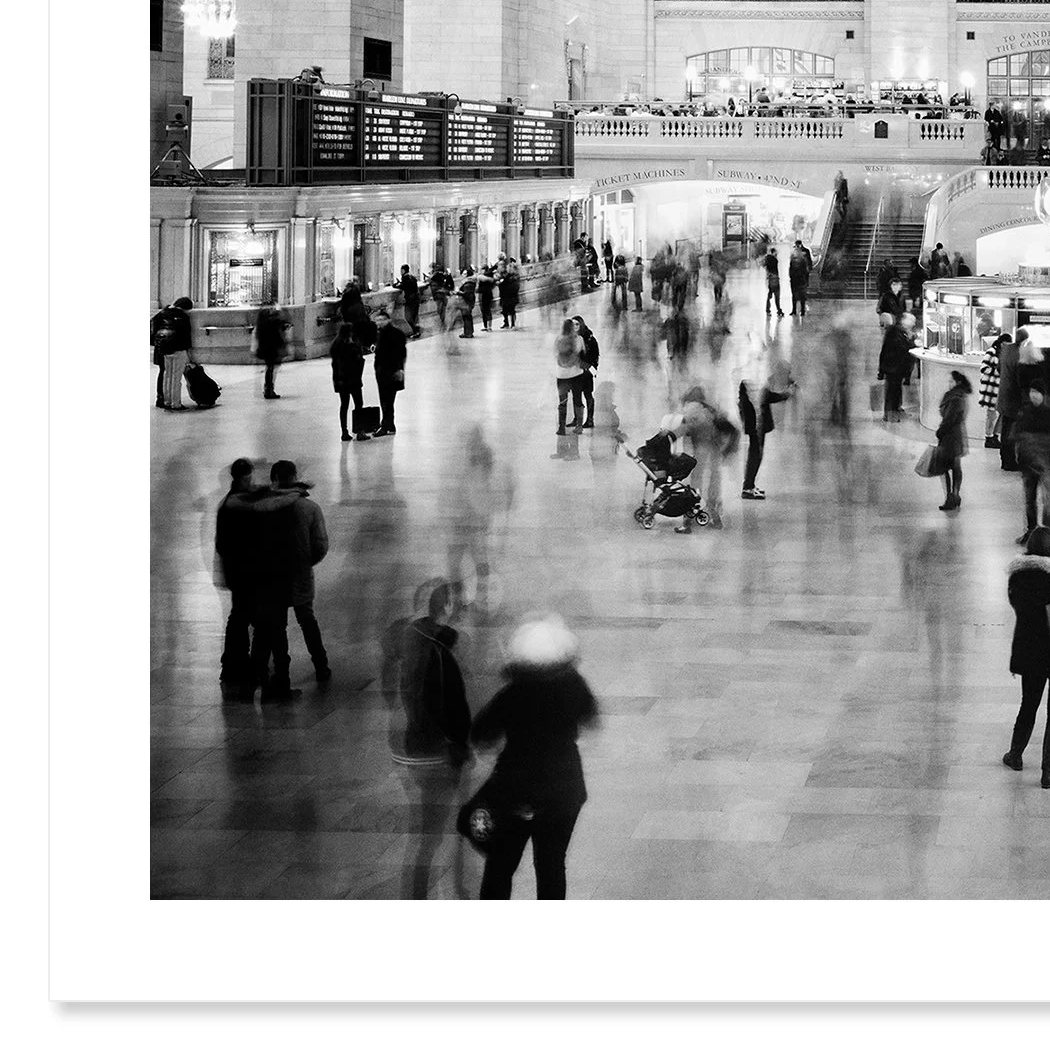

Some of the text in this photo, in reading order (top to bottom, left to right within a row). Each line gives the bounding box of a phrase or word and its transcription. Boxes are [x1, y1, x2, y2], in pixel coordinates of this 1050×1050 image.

[1003, 35, 1016, 43] TO
[995, 42, 1015, 53] THE
[596, 168, 686, 187] TICKET MACHINES
[717, 170, 803, 189] SUBWAY 42ND ST
[979, 222, 1006, 234] DINING
